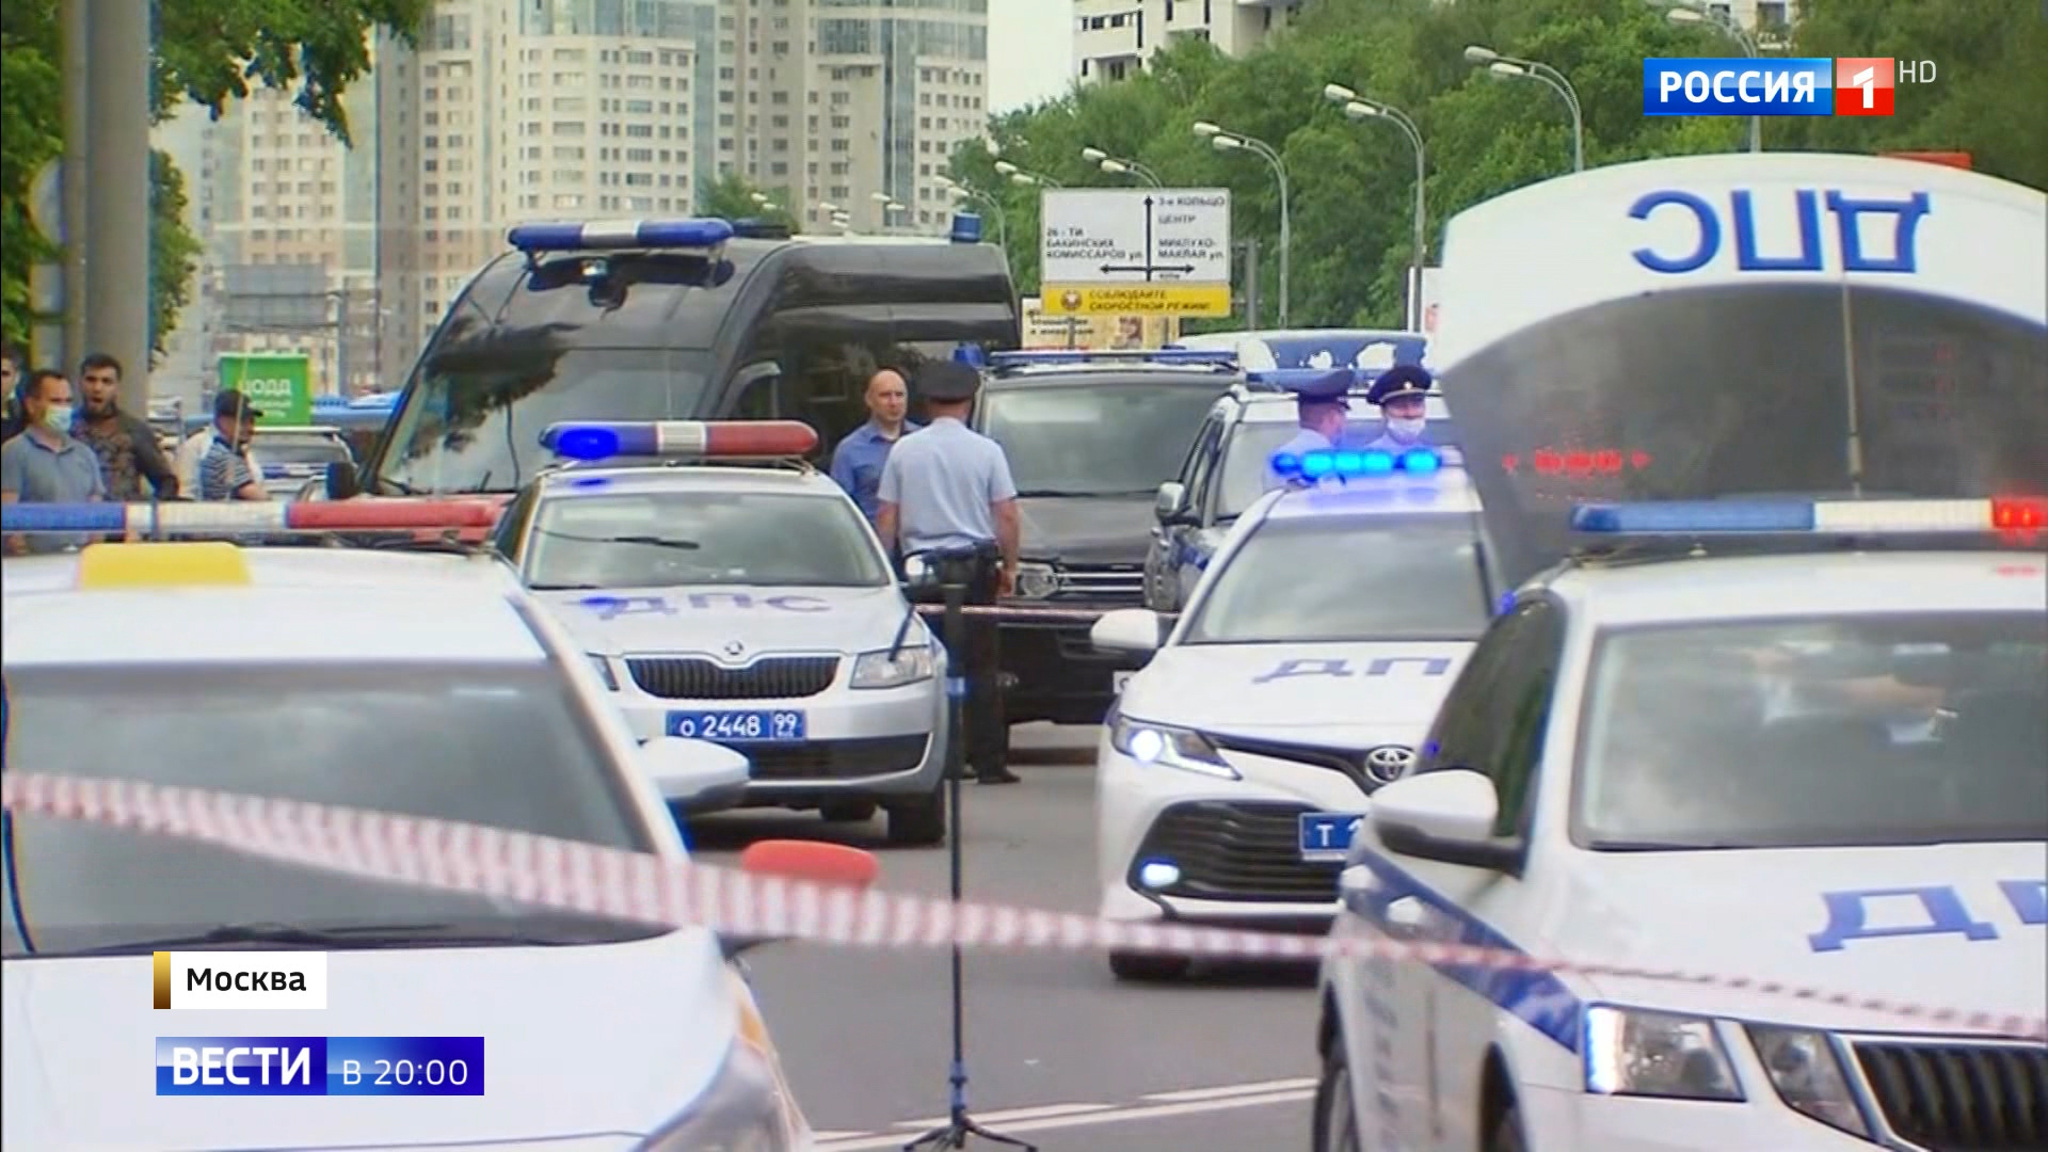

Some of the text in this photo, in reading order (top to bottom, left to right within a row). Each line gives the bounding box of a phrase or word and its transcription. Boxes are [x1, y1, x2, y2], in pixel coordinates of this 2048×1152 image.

[1158, 214, 1197, 225] ЦЕНТР
[1627, 189, 1931, 274] ДПС
[1046, 249, 1126, 259] КОМИССАРОВ
[598, 592, 833, 621] ДПС
[702, 714, 761, 737] 2448
[774, 713, 798, 733] 99
